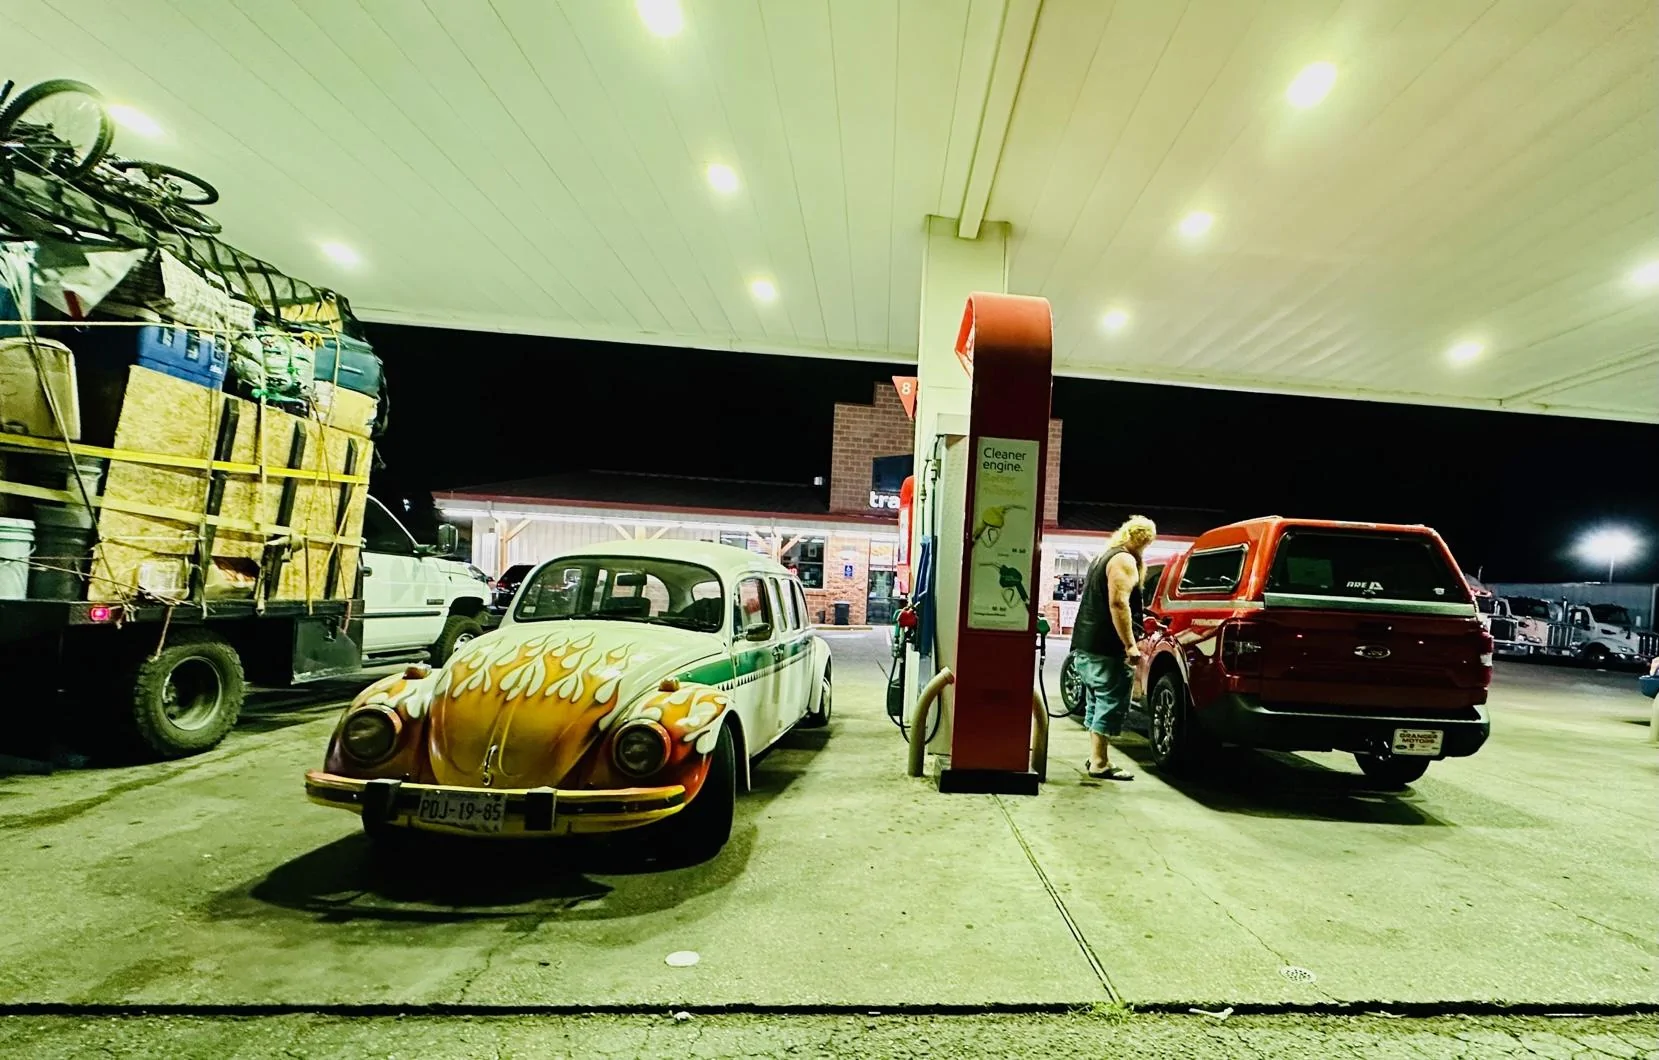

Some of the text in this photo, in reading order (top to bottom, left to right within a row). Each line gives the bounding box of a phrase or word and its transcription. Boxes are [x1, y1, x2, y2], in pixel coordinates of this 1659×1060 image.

[901, 382, 911, 396] 8
[983, 447, 1027, 461] Cleaner
[982, 460, 1024, 473] engine.
